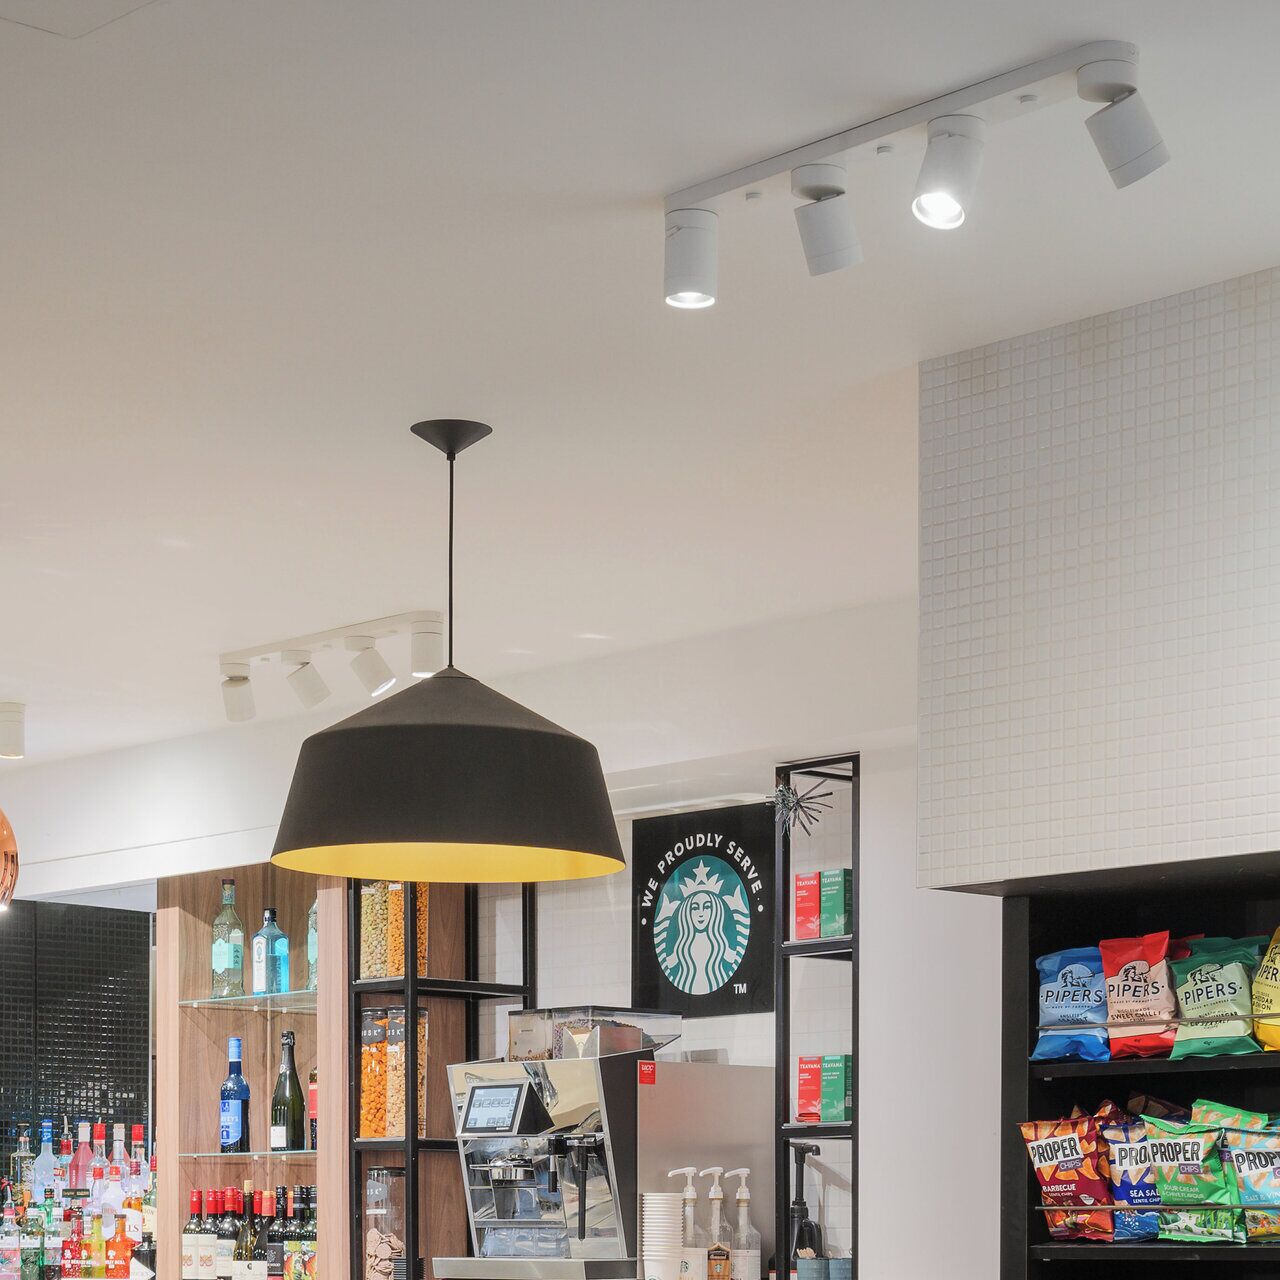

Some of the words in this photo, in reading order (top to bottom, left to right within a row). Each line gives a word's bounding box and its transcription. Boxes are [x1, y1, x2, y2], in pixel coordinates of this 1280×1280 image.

[641, 878, 659, 908] WE
[658, 833, 723, 875] PROUDLY
[726, 841, 763, 894] SERVE
[733, 983, 747, 994] TM
[1045, 989, 1103, 1003] PIPERS
[1109, 981, 1160, 997] PIPERS
[1184, 982, 1237, 1005] PIPERS
[1031, 1137, 1080, 1163] PROPER
[1119, 1146, 1148, 1166] PRO
[1150, 1141, 1201, 1163] PROPER
[1060, 1160, 1081, 1169] CHIPS
[1180, 1164, 1199, 1173] CHIPS
[1042, 1184, 1076, 1192] BARBECUE
